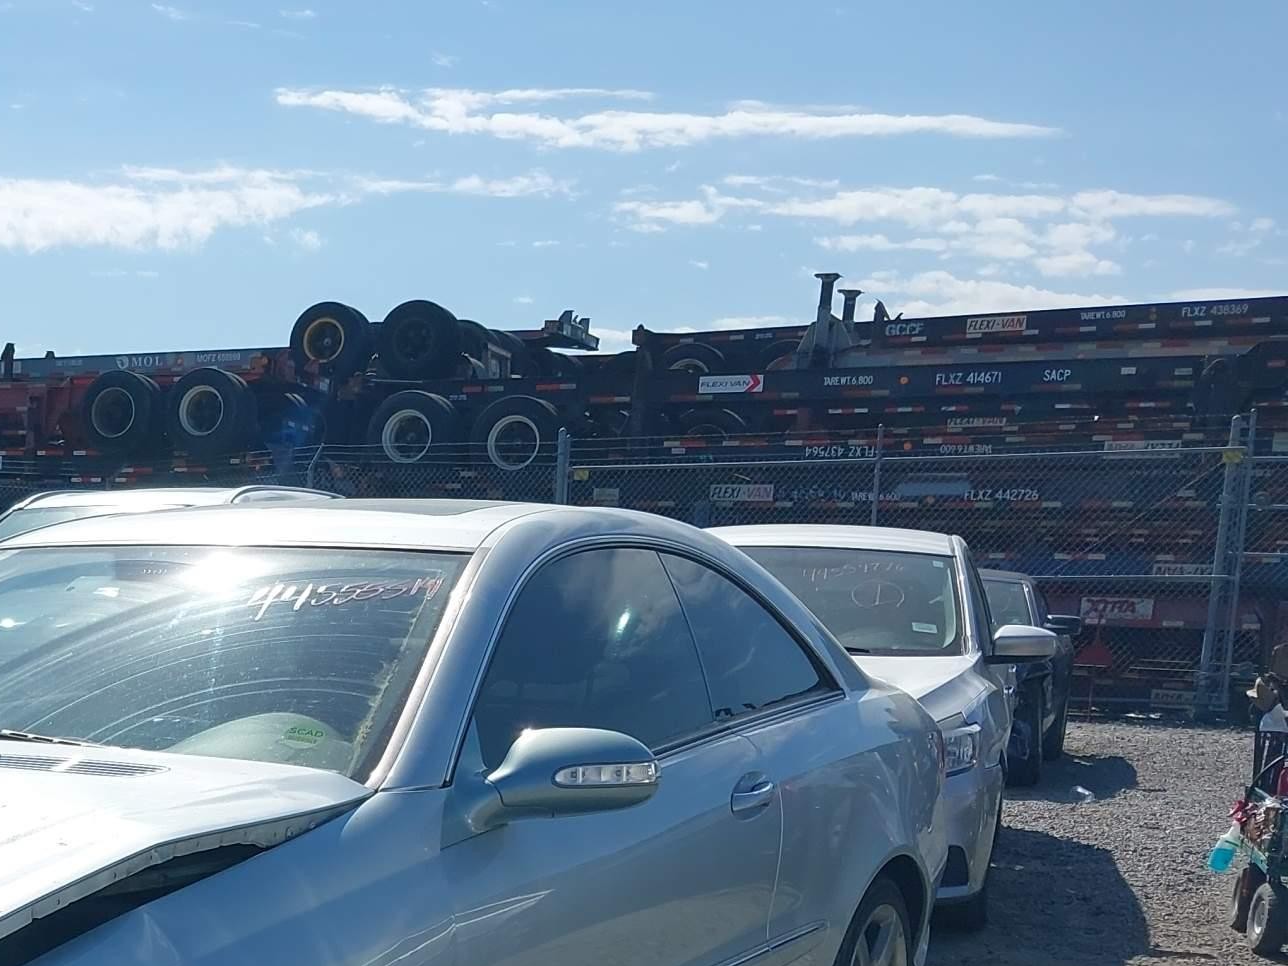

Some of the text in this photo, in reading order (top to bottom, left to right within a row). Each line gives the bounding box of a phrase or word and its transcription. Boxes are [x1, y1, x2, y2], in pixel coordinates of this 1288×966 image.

[1181, 306, 1206, 317] FLXZ
[967, 317, 1025, 331] FLEXI-VAN
[131, 355, 163, 368] MOL
[935, 371, 1002, 385] FLXZ 414671
[1043, 369, 1072, 382] SACP
[964, 489, 992, 500] FLXZ
[287, 727, 324, 737] SCAD
